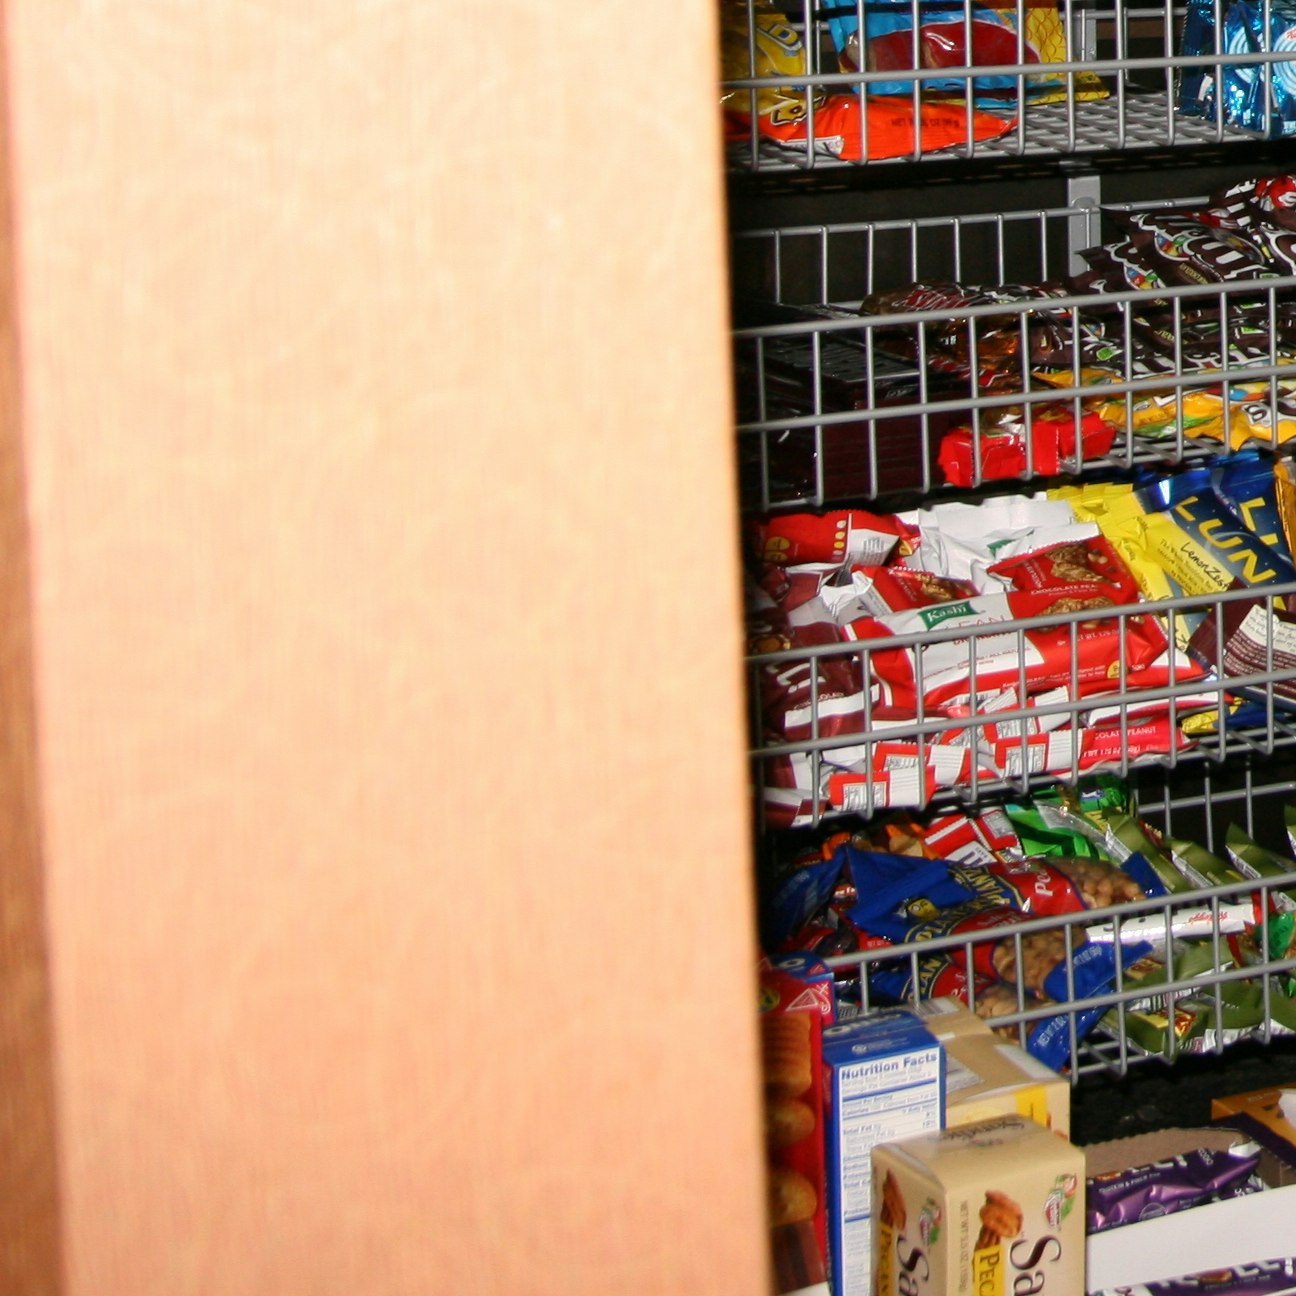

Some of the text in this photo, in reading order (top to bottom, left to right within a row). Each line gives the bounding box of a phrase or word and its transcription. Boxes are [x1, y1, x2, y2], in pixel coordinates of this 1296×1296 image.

[1174, 496, 1277, 584] LUN
[927, 603, 968, 623] Kashi
[841, 1051, 939, 1081] Nutrition Facts
